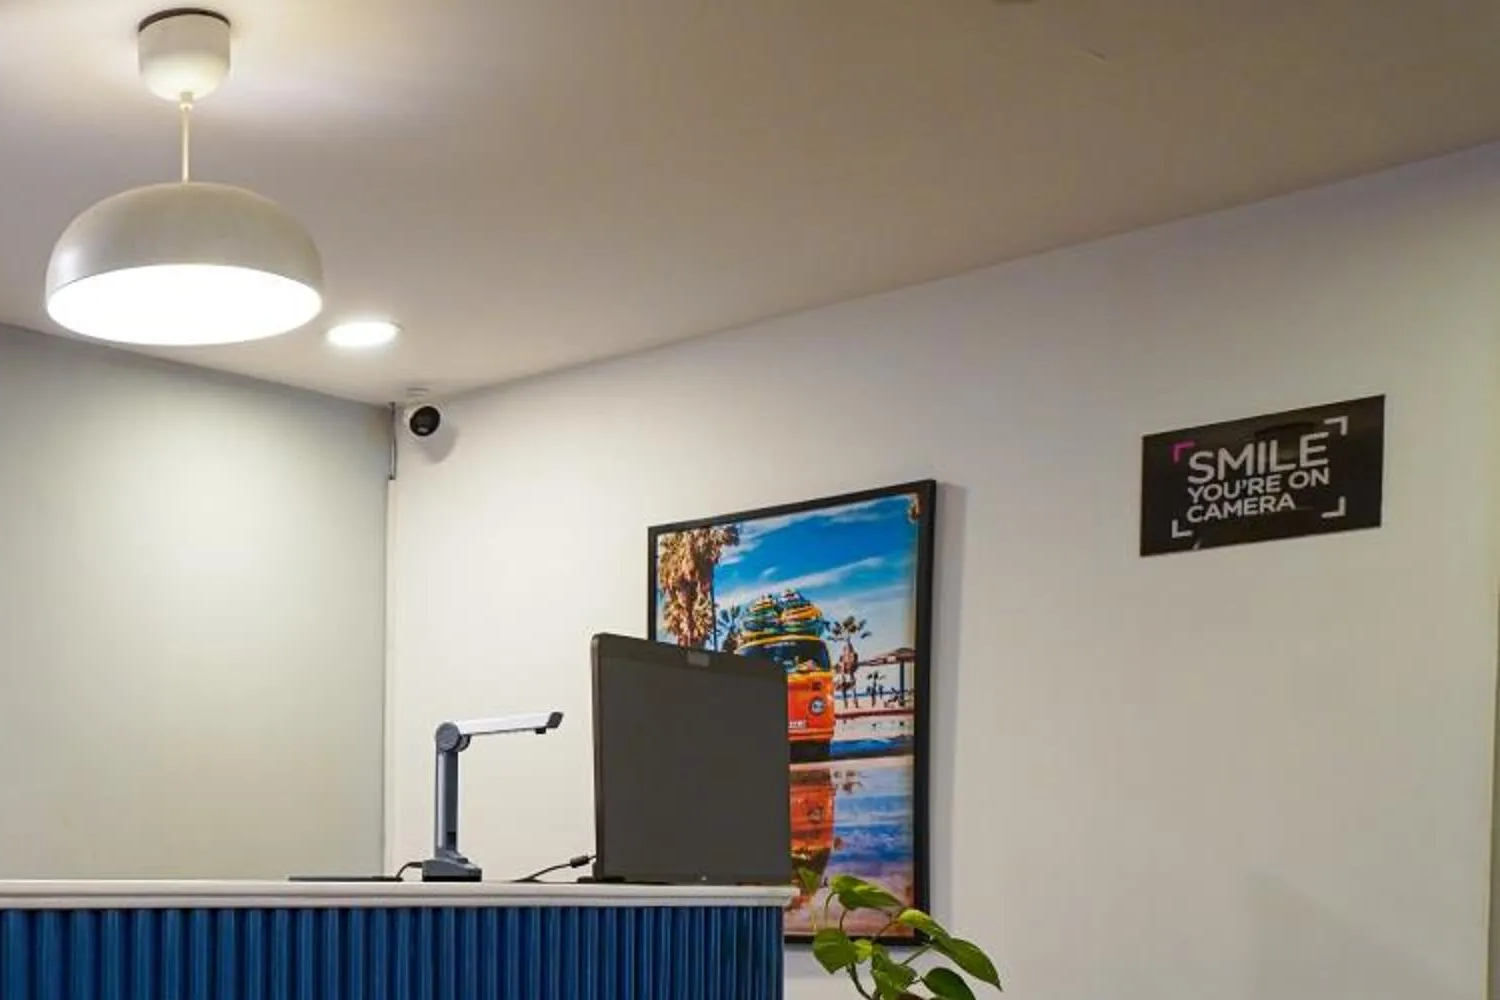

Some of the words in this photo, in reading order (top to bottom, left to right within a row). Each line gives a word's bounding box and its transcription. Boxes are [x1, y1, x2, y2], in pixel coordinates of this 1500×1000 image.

[1187, 431, 1330, 485] SMILE
[1187, 474, 1282, 504] YOU'RE
[1288, 467, 1331, 489] ON
[1186, 493, 1297, 523] CAMERA
